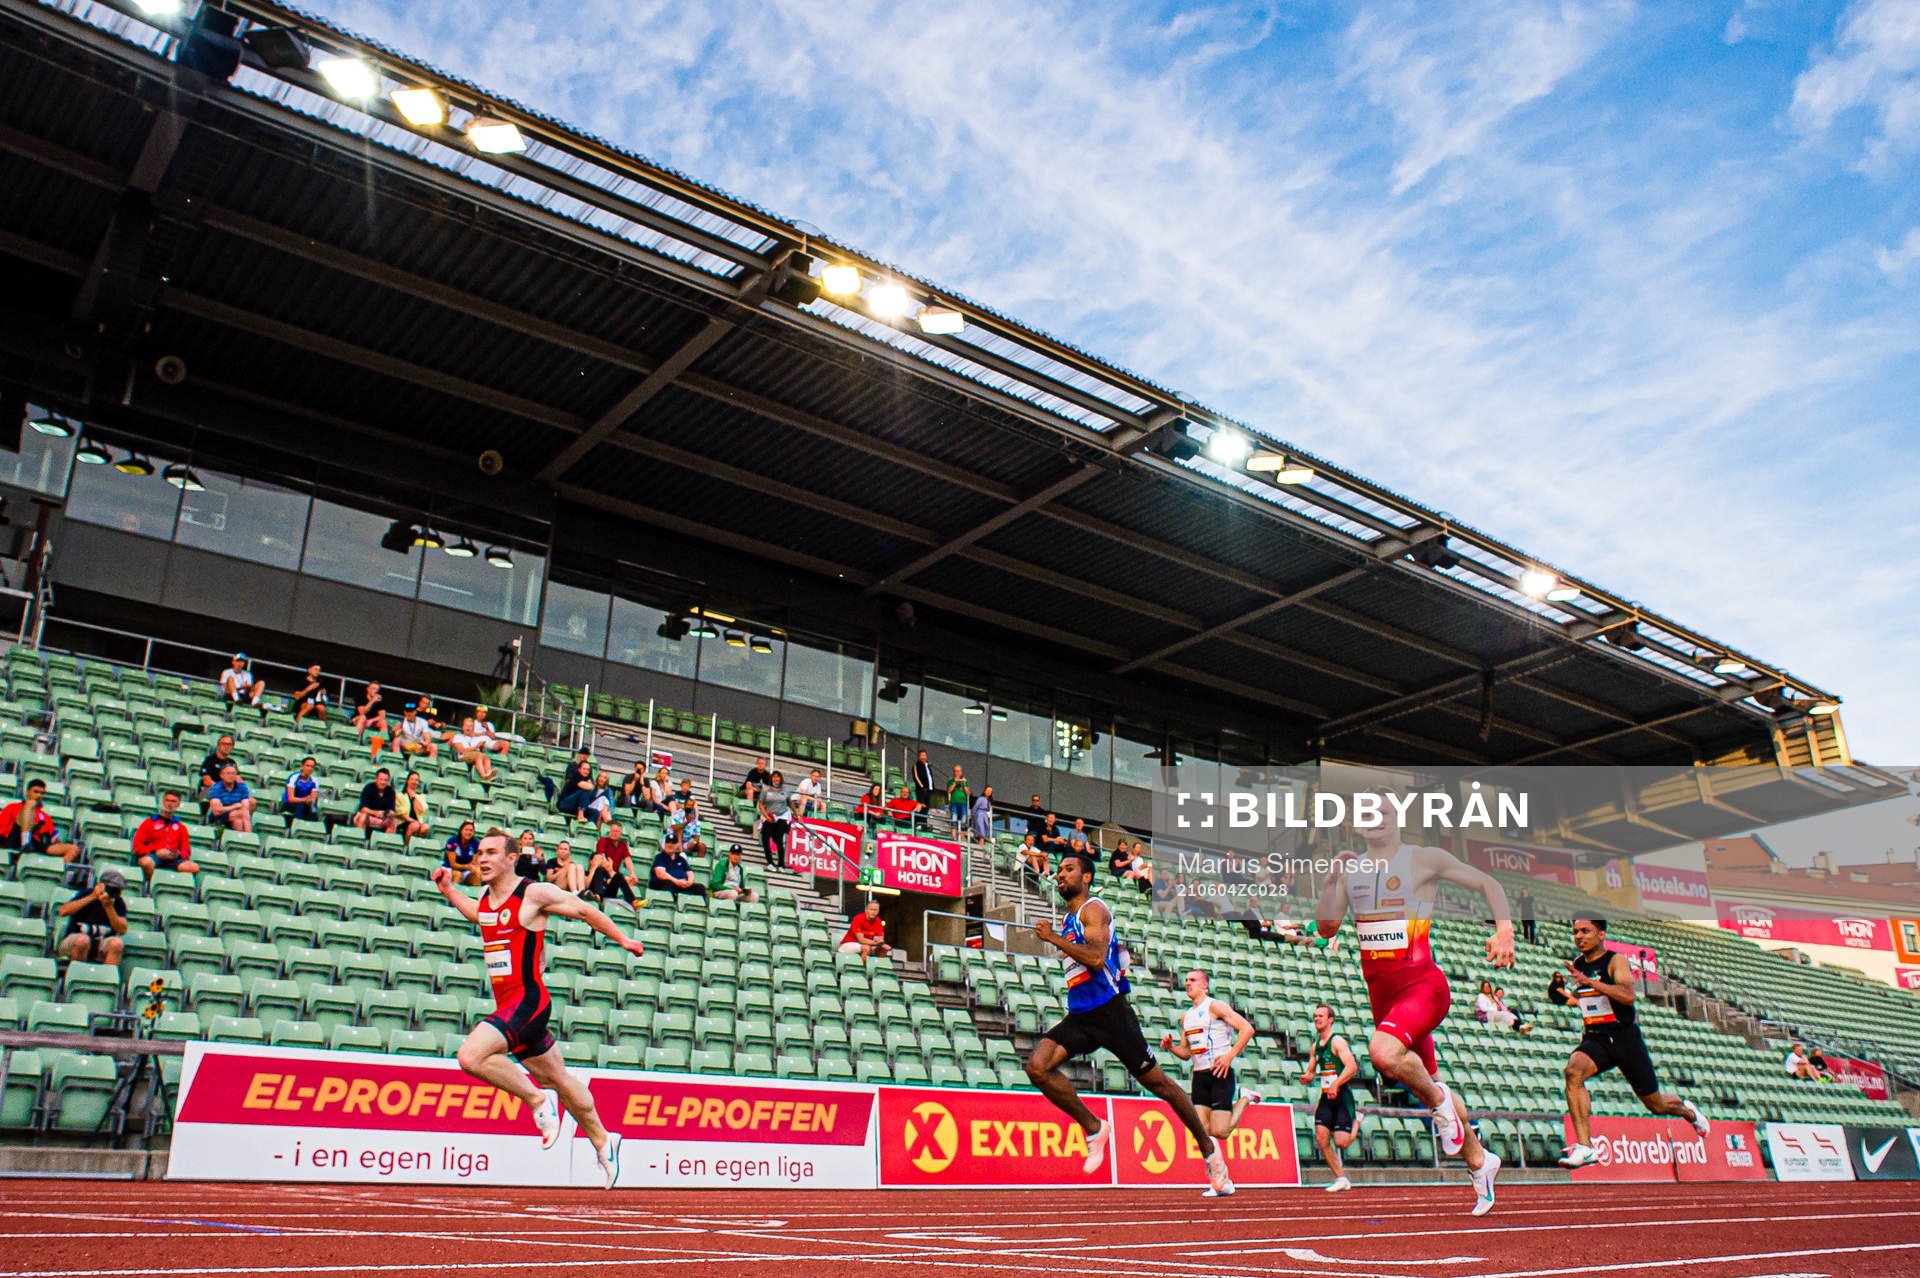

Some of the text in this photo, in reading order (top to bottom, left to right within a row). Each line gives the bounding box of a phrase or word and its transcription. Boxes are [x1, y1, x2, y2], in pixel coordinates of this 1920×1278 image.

[790, 823, 857, 855] HON
[881, 841, 957, 874] THON
[1483, 847, 1535, 872] THON
[897, 870, 942, 888] HOTELS
[1730, 905, 1776, 928] THON
[1832, 917, 1876, 939] THON
[242, 1072, 522, 1121] EL-PROFFEN
[622, 1094, 838, 1133] EL-PROFFEN
[970, 1120, 1089, 1158] EXTRA
[1185, 1125, 1279, 1160] ETRA
[1612, 1133, 1708, 1165] storebrand
[294, 1141, 301, 1167] i
[312, 1147, 347, 1168] en
[360, 1148, 432, 1175] egen
[443, 1147, 489, 1176] liga
[665, 1153, 670, 1175] i
[678, 1158, 707, 1176] en
[715, 1159, 770, 1182] egen
[778, 1155, 814, 1182] liga
